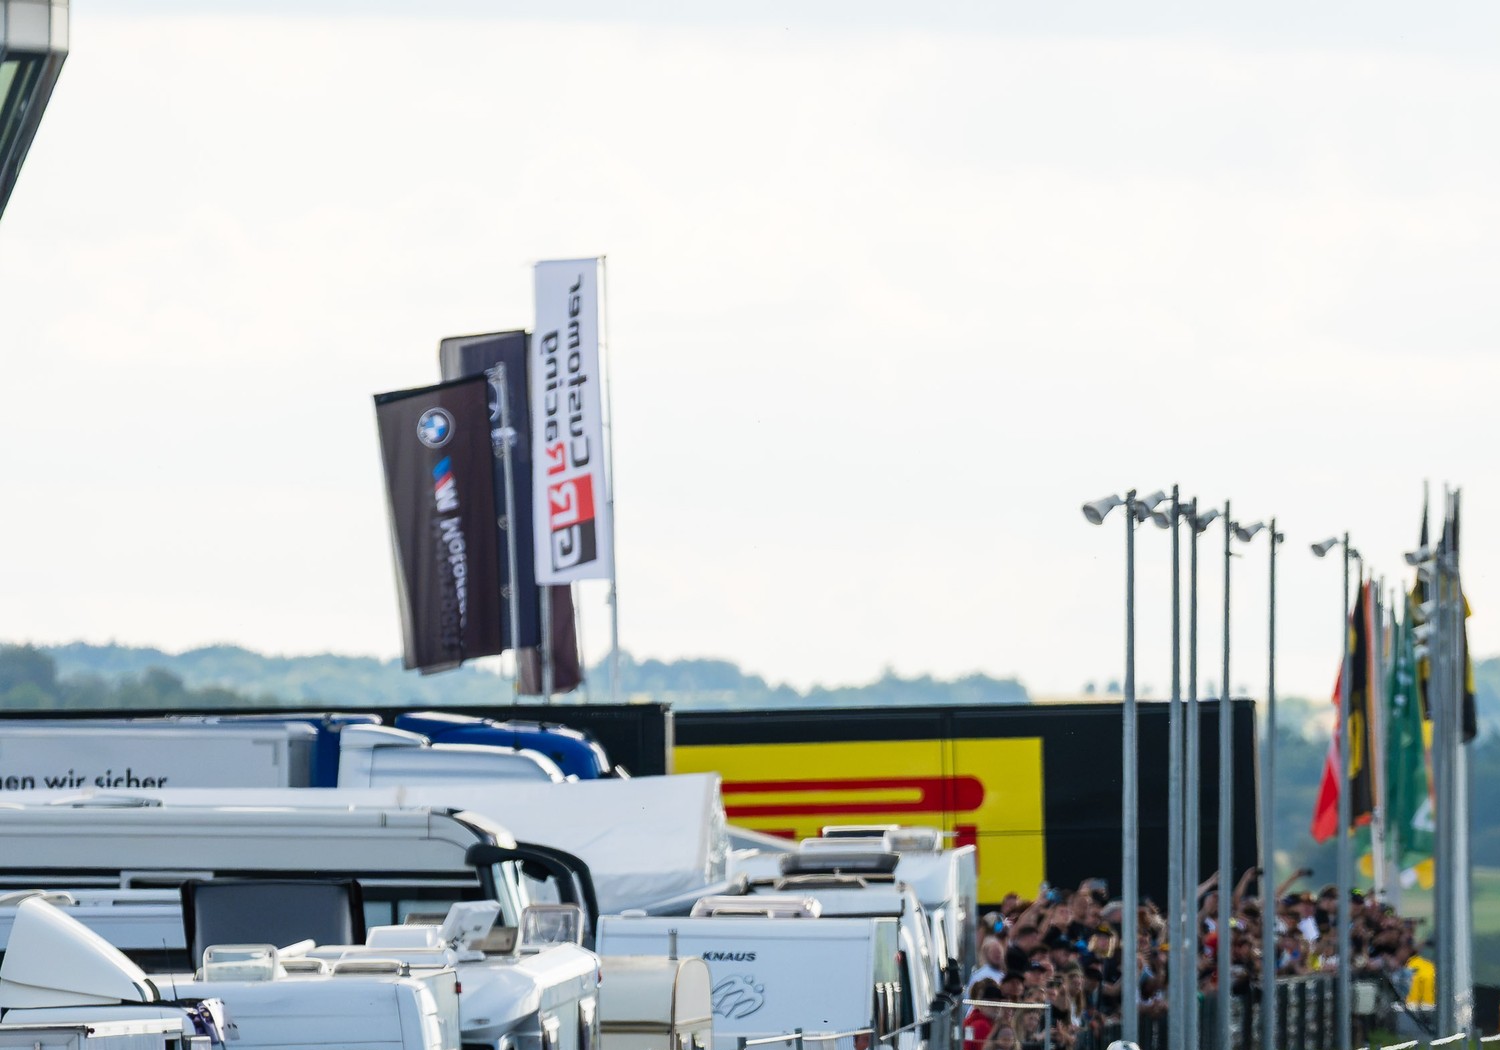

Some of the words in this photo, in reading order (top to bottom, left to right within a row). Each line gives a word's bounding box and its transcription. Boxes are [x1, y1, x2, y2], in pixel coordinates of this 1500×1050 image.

[0, 773, 36, 791] en
[44, 768, 87, 789] wir
[95, 767, 168, 789] sicher
[703, 951, 757, 962] KNAUS
